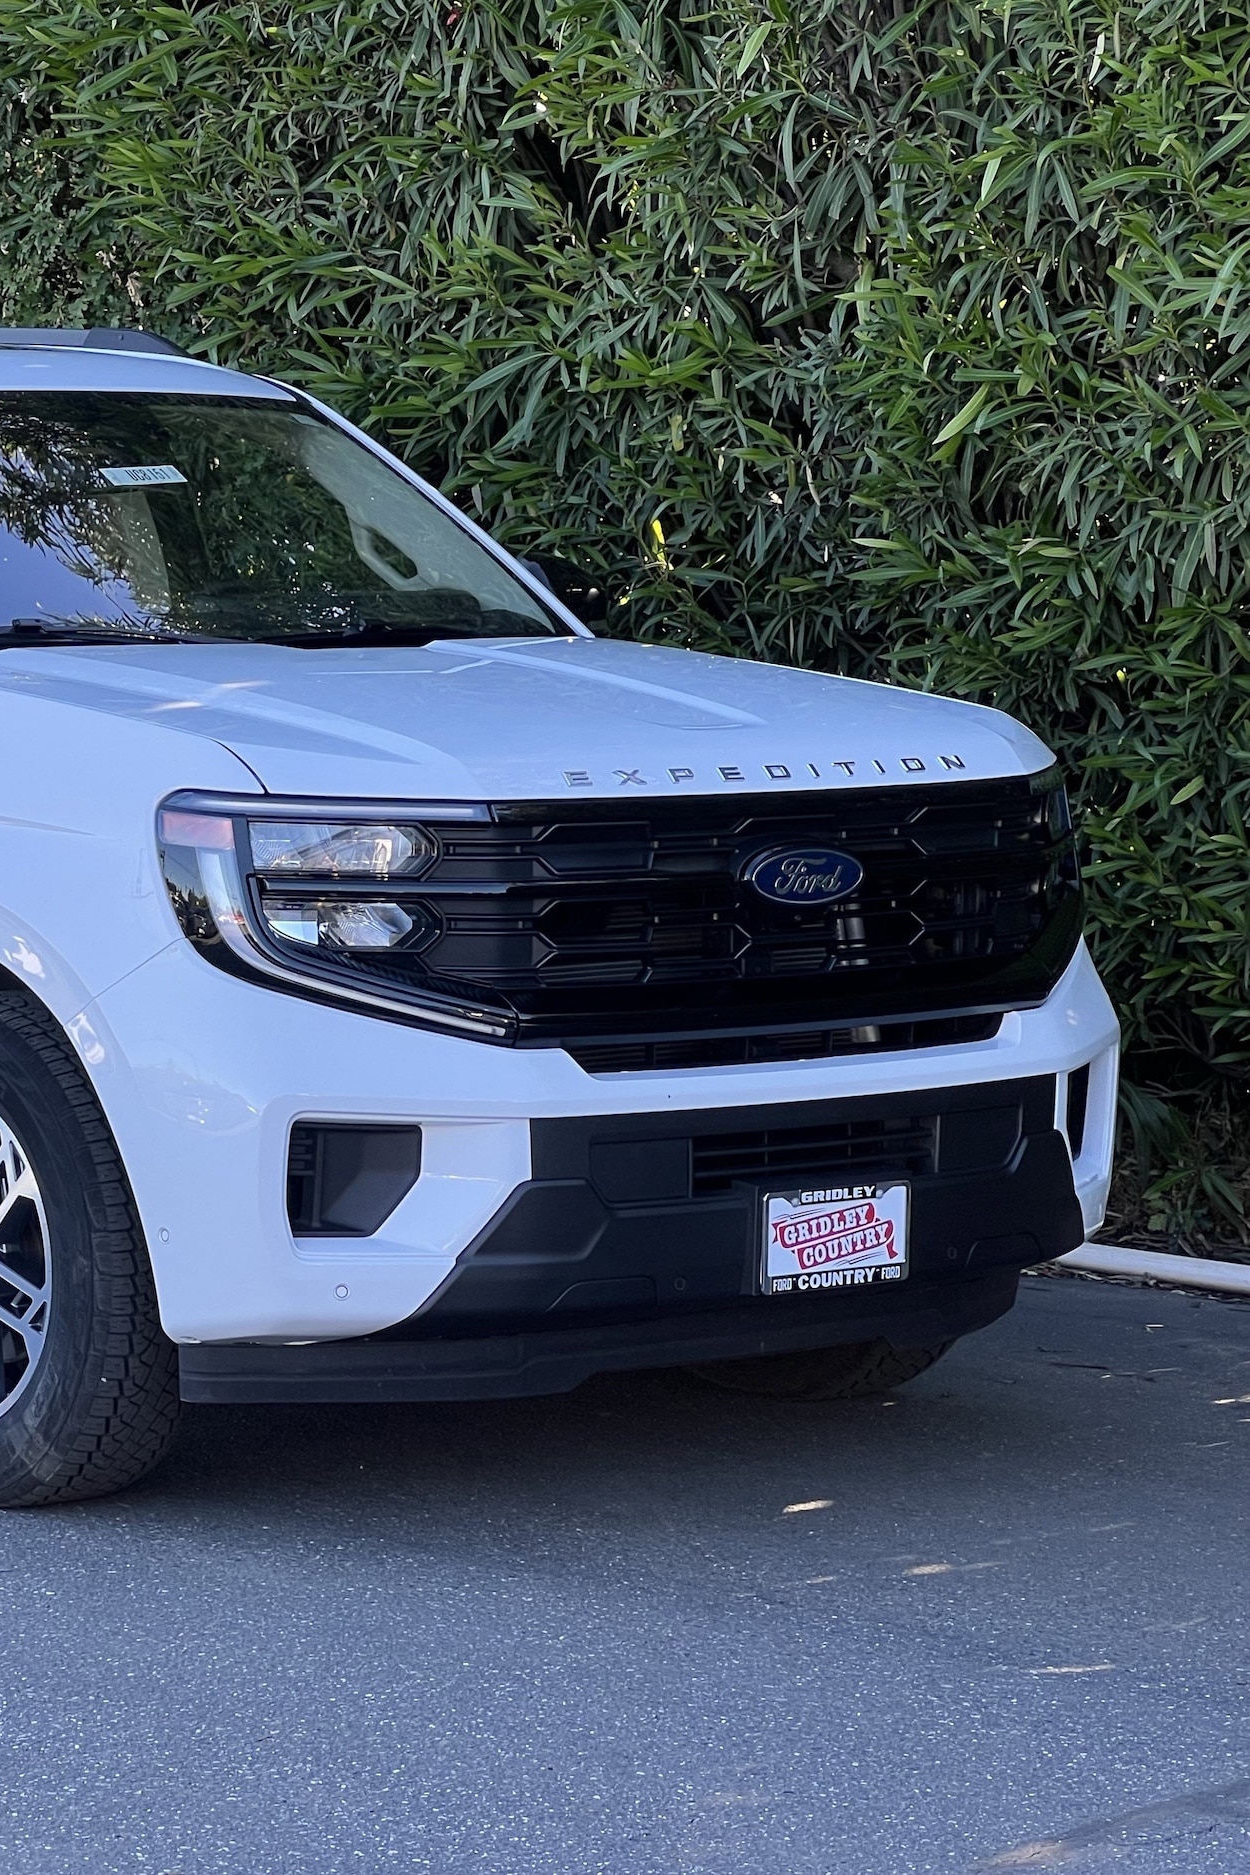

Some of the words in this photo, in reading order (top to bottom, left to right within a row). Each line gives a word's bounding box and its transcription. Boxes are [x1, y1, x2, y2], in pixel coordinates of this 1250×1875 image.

[562, 754, 966, 788] EXPEDITION
[774, 857, 843, 895] Ford
[801, 1185, 875, 1203] GRIDLEY
[783, 1205, 870, 1245] GRIDLEY
[802, 1223, 889, 1267] COUNTRY
[772, 1278, 793, 1293] FORD
[797, 1267, 876, 1290] COUNTRY
[880, 1265, 901, 1280] FORD
